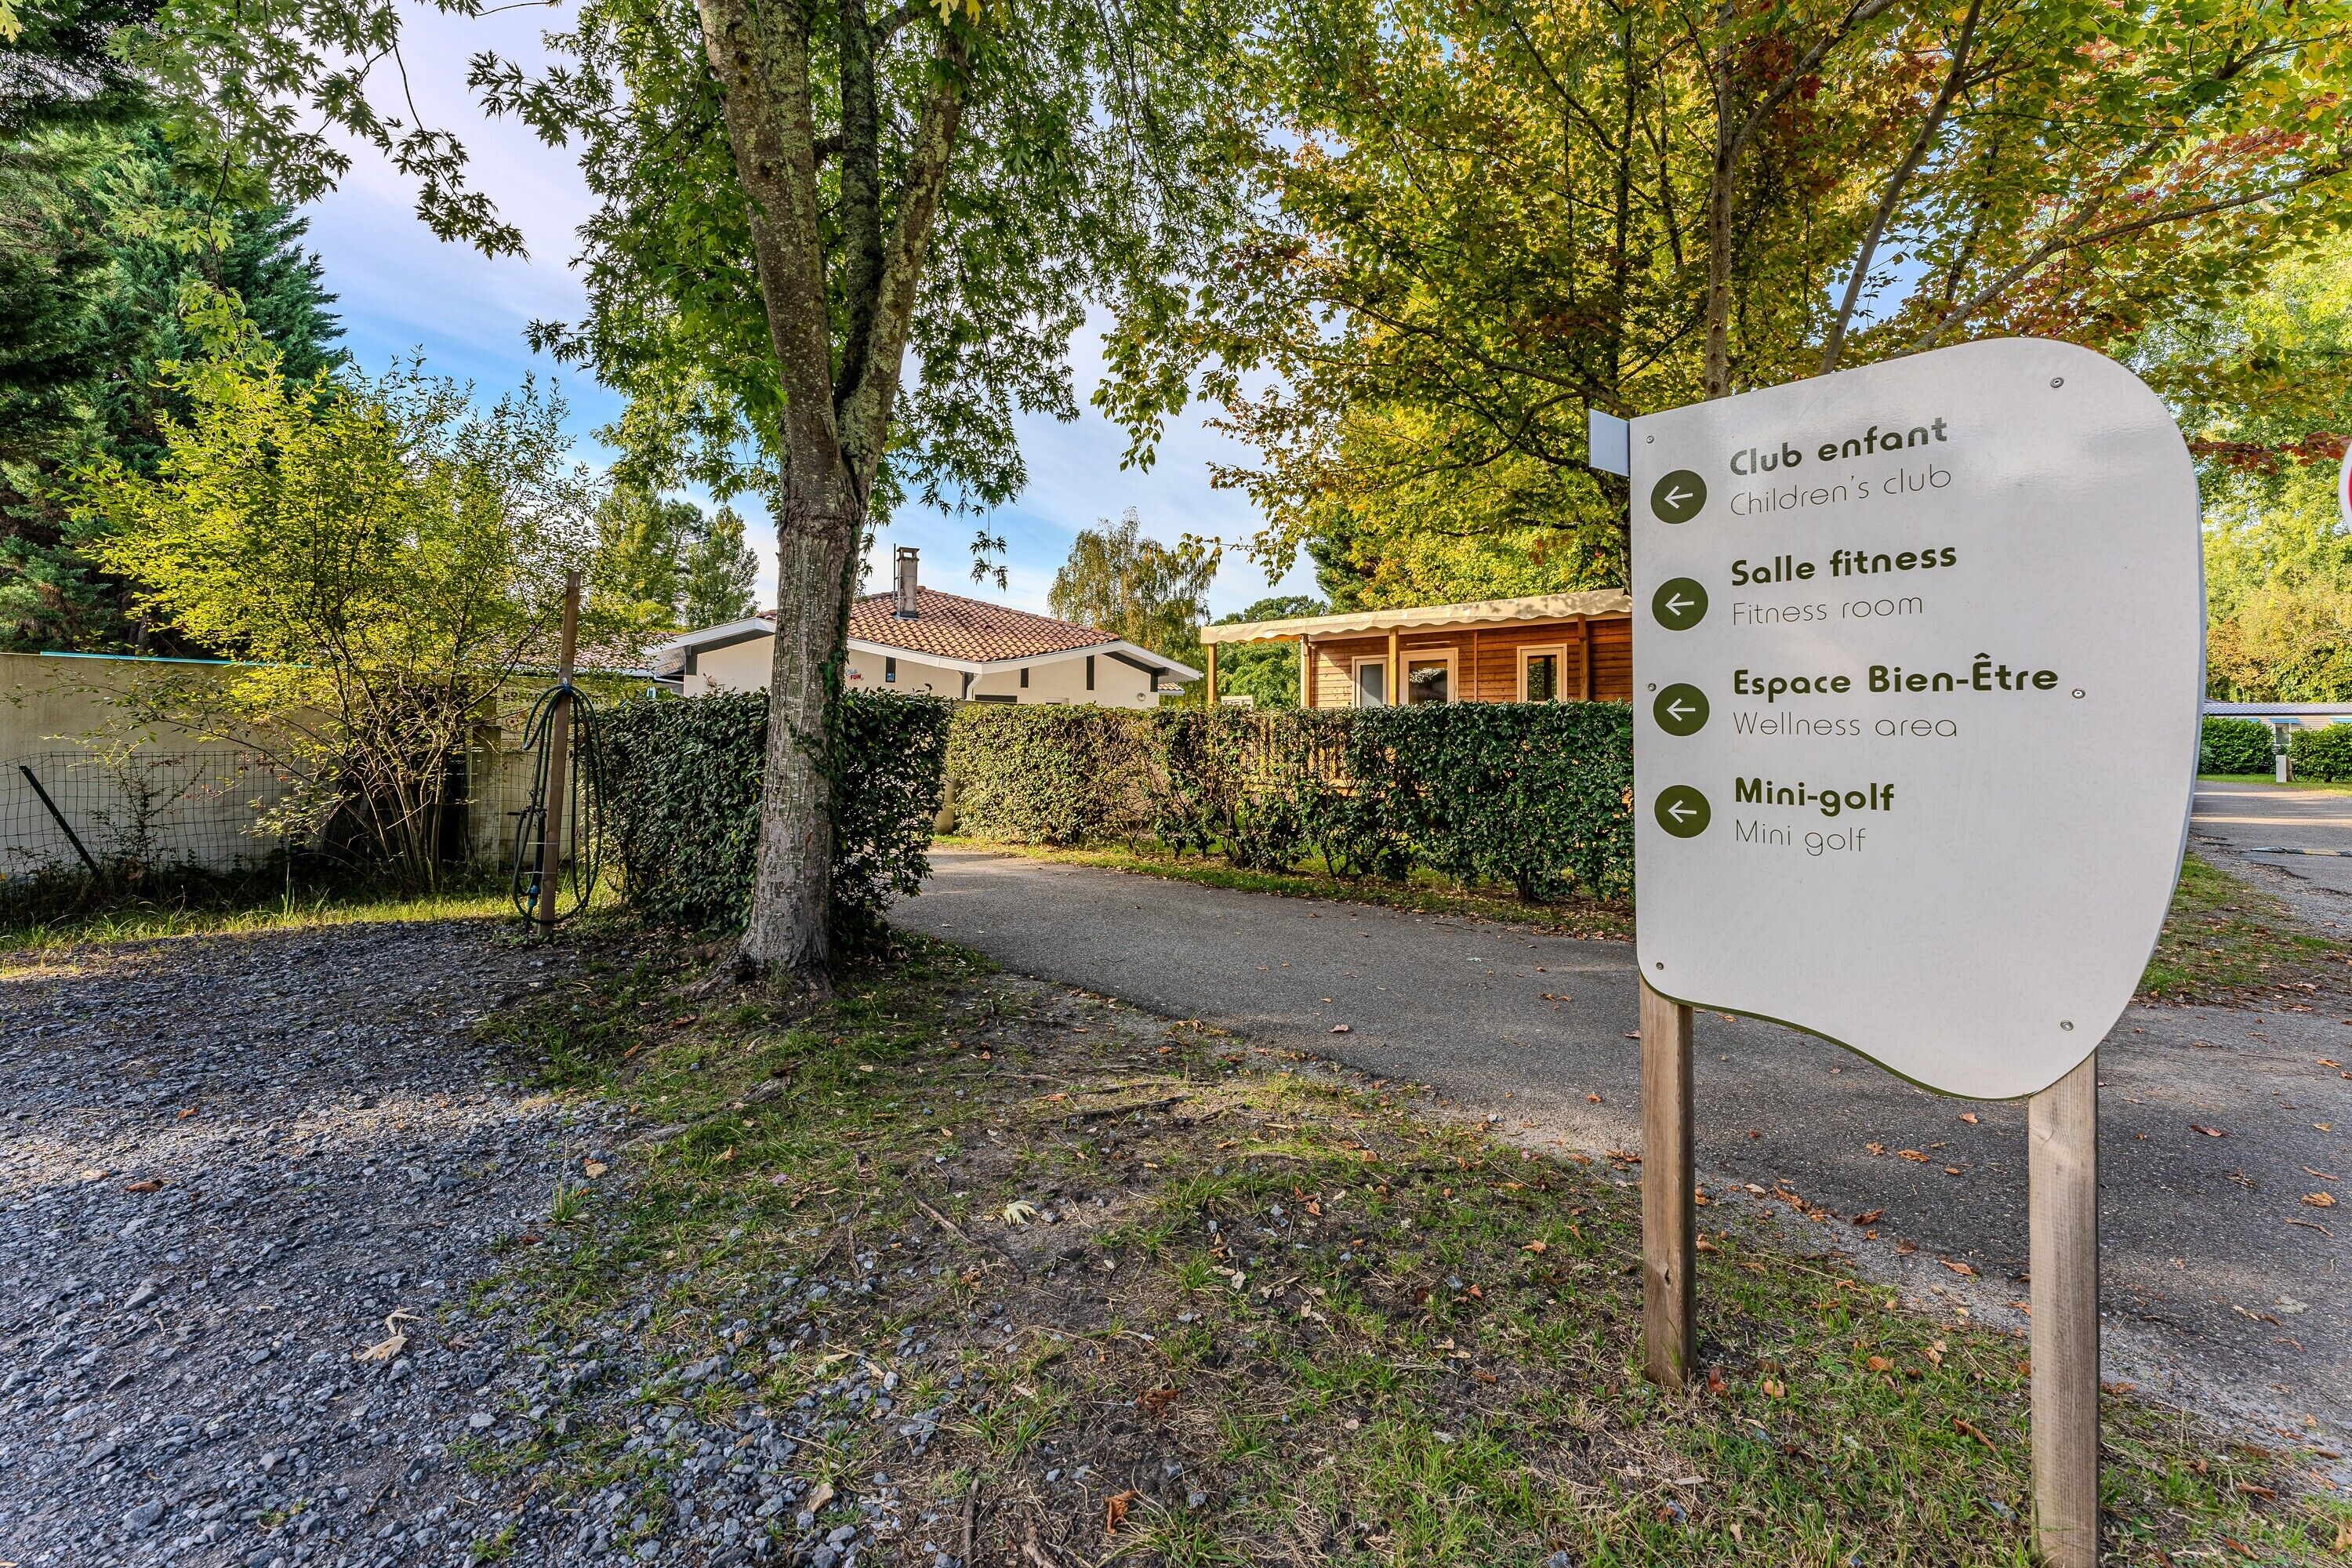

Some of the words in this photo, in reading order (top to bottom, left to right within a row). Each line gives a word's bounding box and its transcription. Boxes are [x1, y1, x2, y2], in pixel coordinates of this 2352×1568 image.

[1730, 441, 1803, 477] Club
[1817, 416, 1948, 462] enfant
[1731, 475, 1871, 516] Children's
[1884, 463, 1951, 495] club
[1731, 554, 1816, 590] Salle
[1829, 546, 1958, 578] fitness
[1733, 601, 1828, 626] Fitness
[1842, 597, 1923, 619] room
[1733, 669, 1852, 705] Espace
[1869, 652, 2060, 693] Bien-Être
[1733, 711, 1860, 736] Wellness
[1875, 719, 1957, 738] area
[1735, 776, 1895, 818] Mini-golf
[1736, 818, 1791, 846] Mini
[1805, 826, 1867, 857] golf
